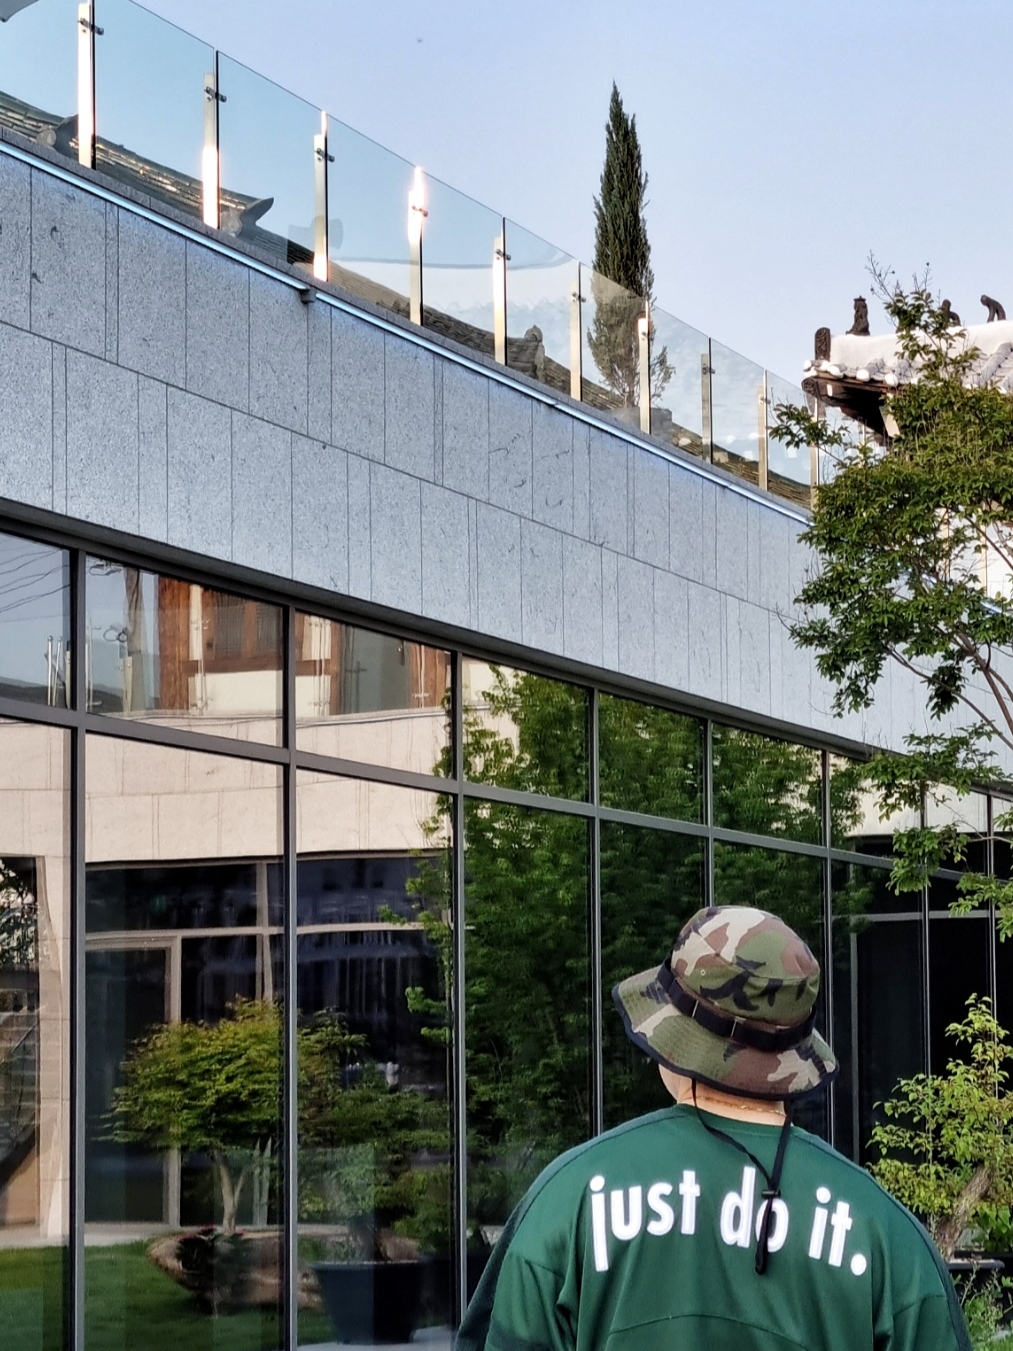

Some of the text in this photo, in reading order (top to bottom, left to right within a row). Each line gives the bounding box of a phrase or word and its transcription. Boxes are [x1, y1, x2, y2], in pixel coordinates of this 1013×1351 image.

[590, 1166, 867, 1276] just do it.
